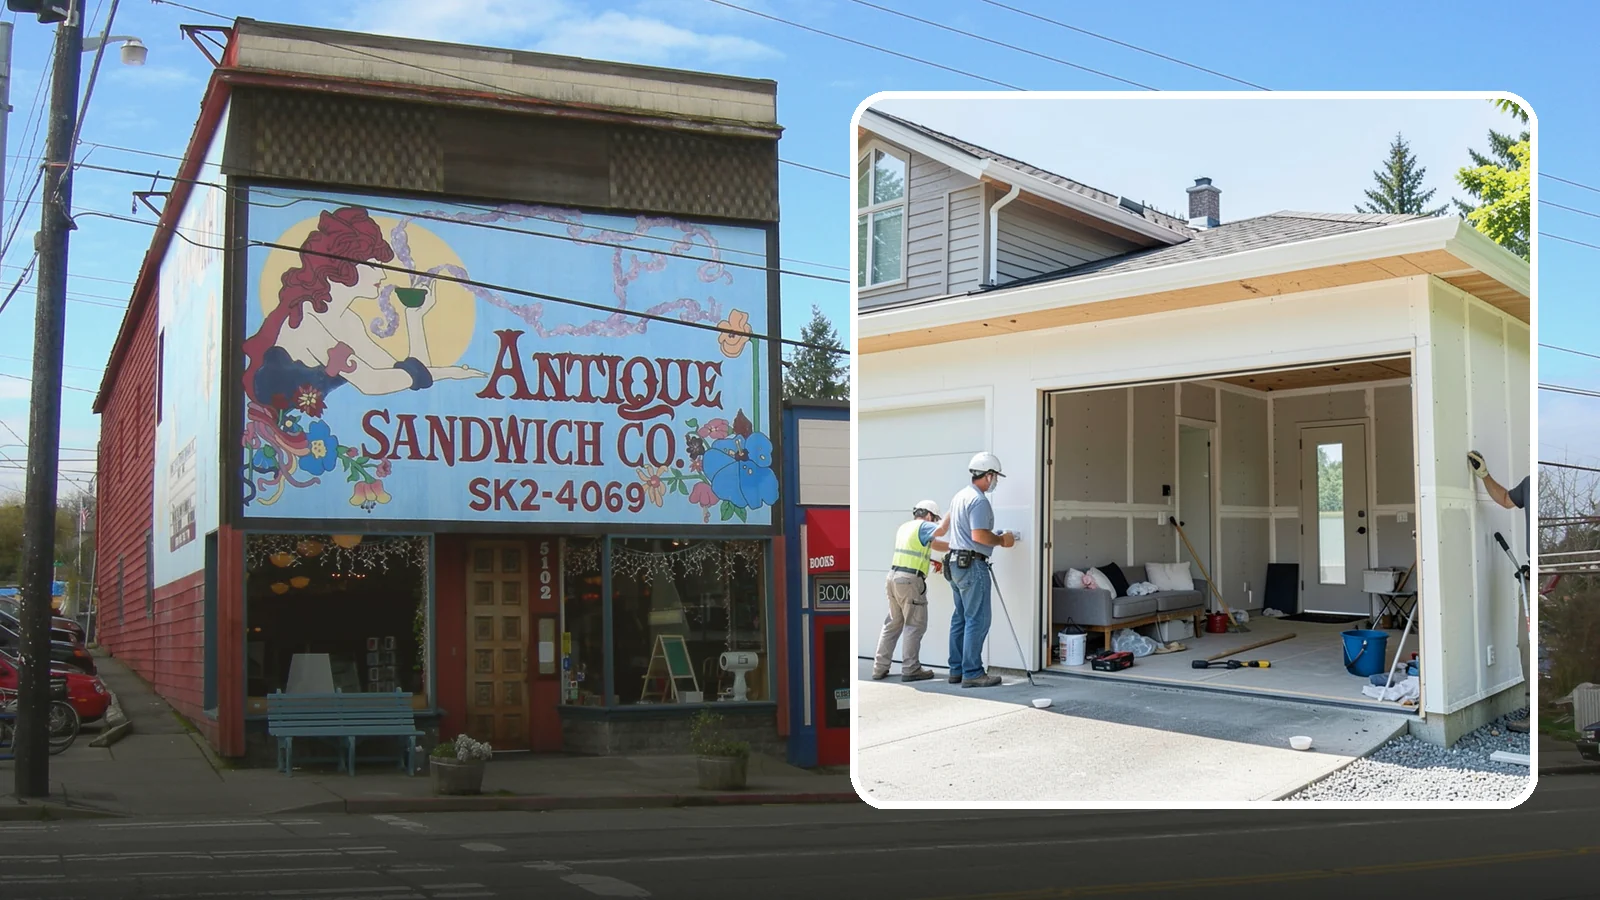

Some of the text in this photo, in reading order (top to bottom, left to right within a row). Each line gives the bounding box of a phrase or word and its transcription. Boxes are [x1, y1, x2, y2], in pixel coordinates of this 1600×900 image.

[361, 408, 686, 468] SANDWICH CO.
[468, 476, 646, 514] SK2-4069
[540, 541, 552, 600] 5102
[809, 555, 835, 569] BOOKS
